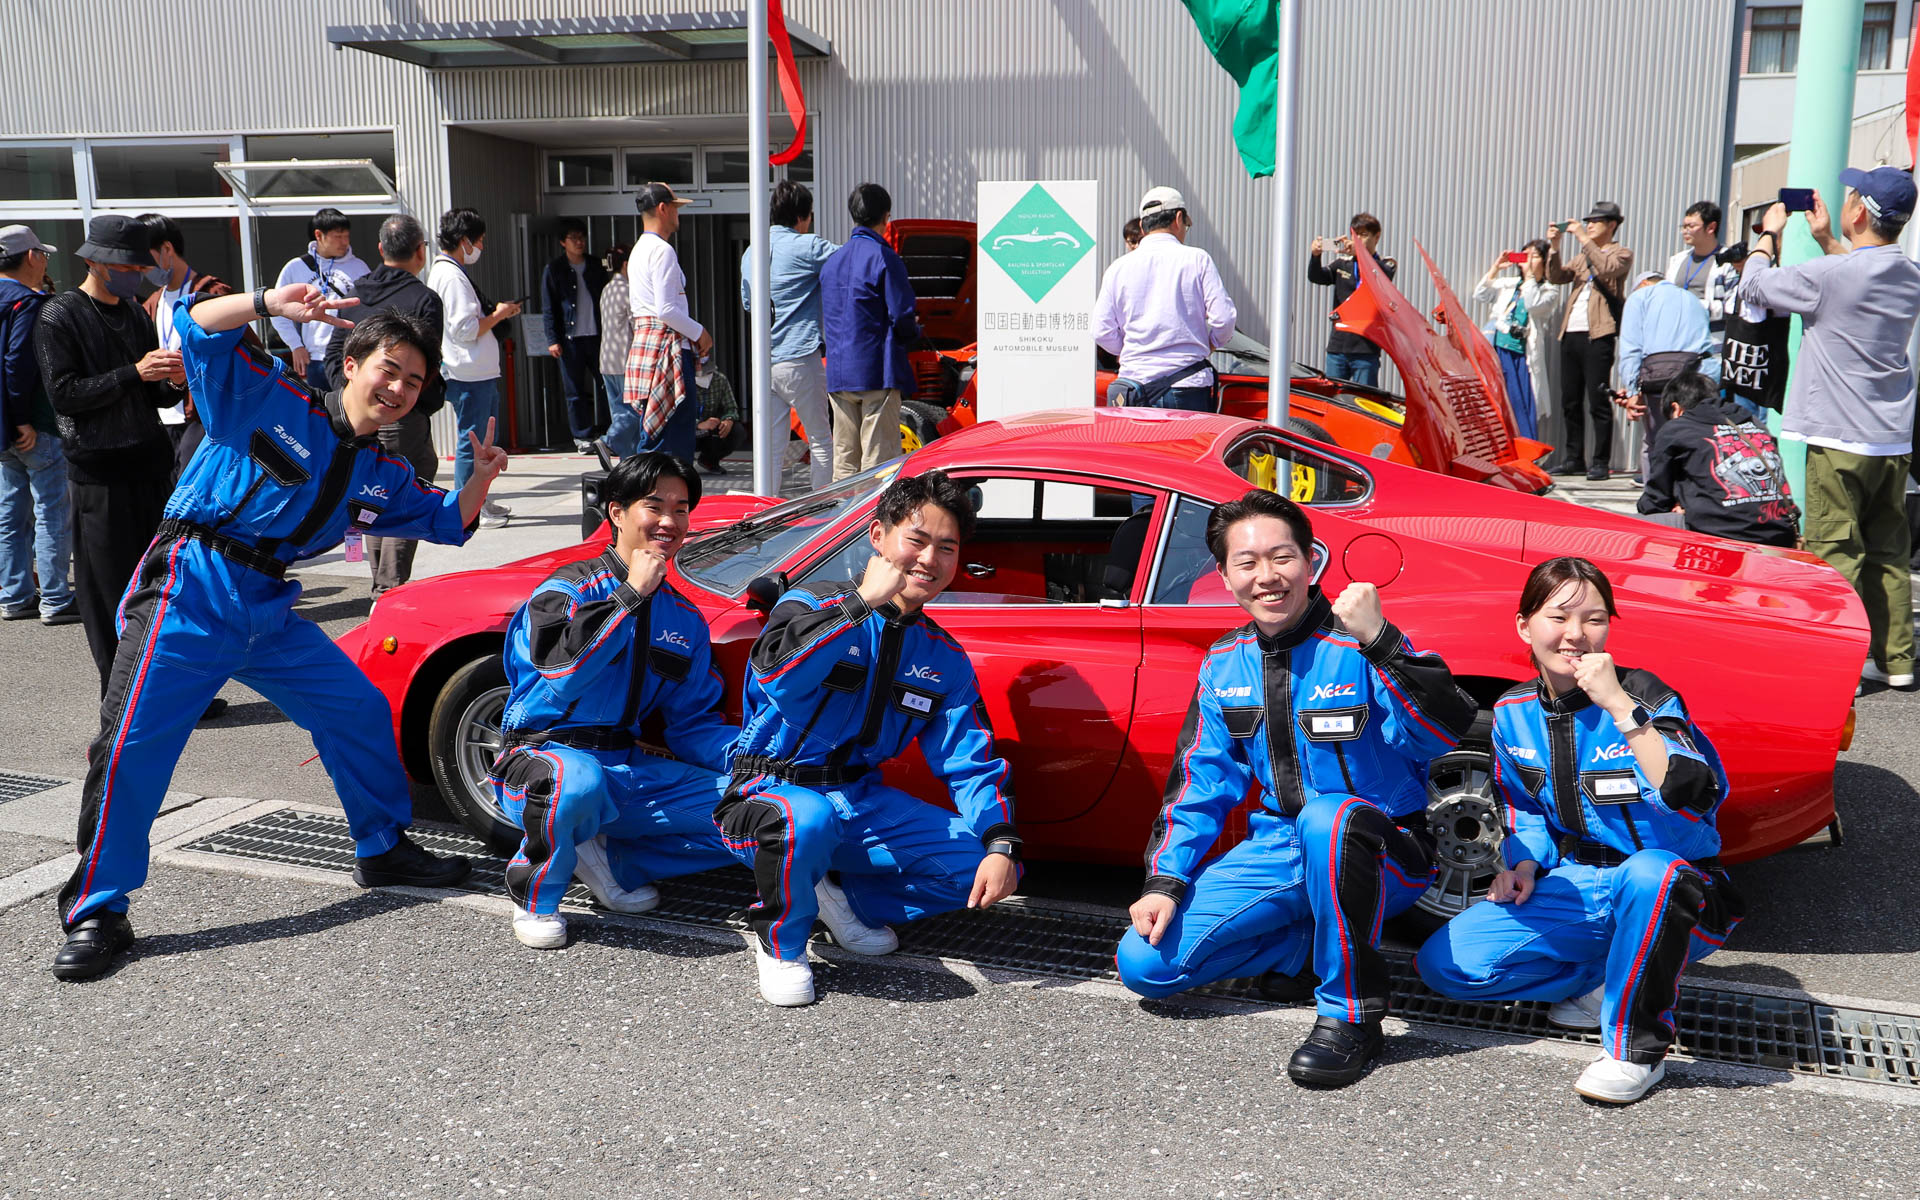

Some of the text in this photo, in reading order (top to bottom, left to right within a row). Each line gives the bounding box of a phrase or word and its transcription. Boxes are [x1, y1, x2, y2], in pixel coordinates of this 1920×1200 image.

[984, 312, 1089, 331] 四国自動車博物館
[1726, 338, 1769, 368] THE
[1722, 358, 1769, 391] MET
[1308, 683, 1356, 701] Netz
